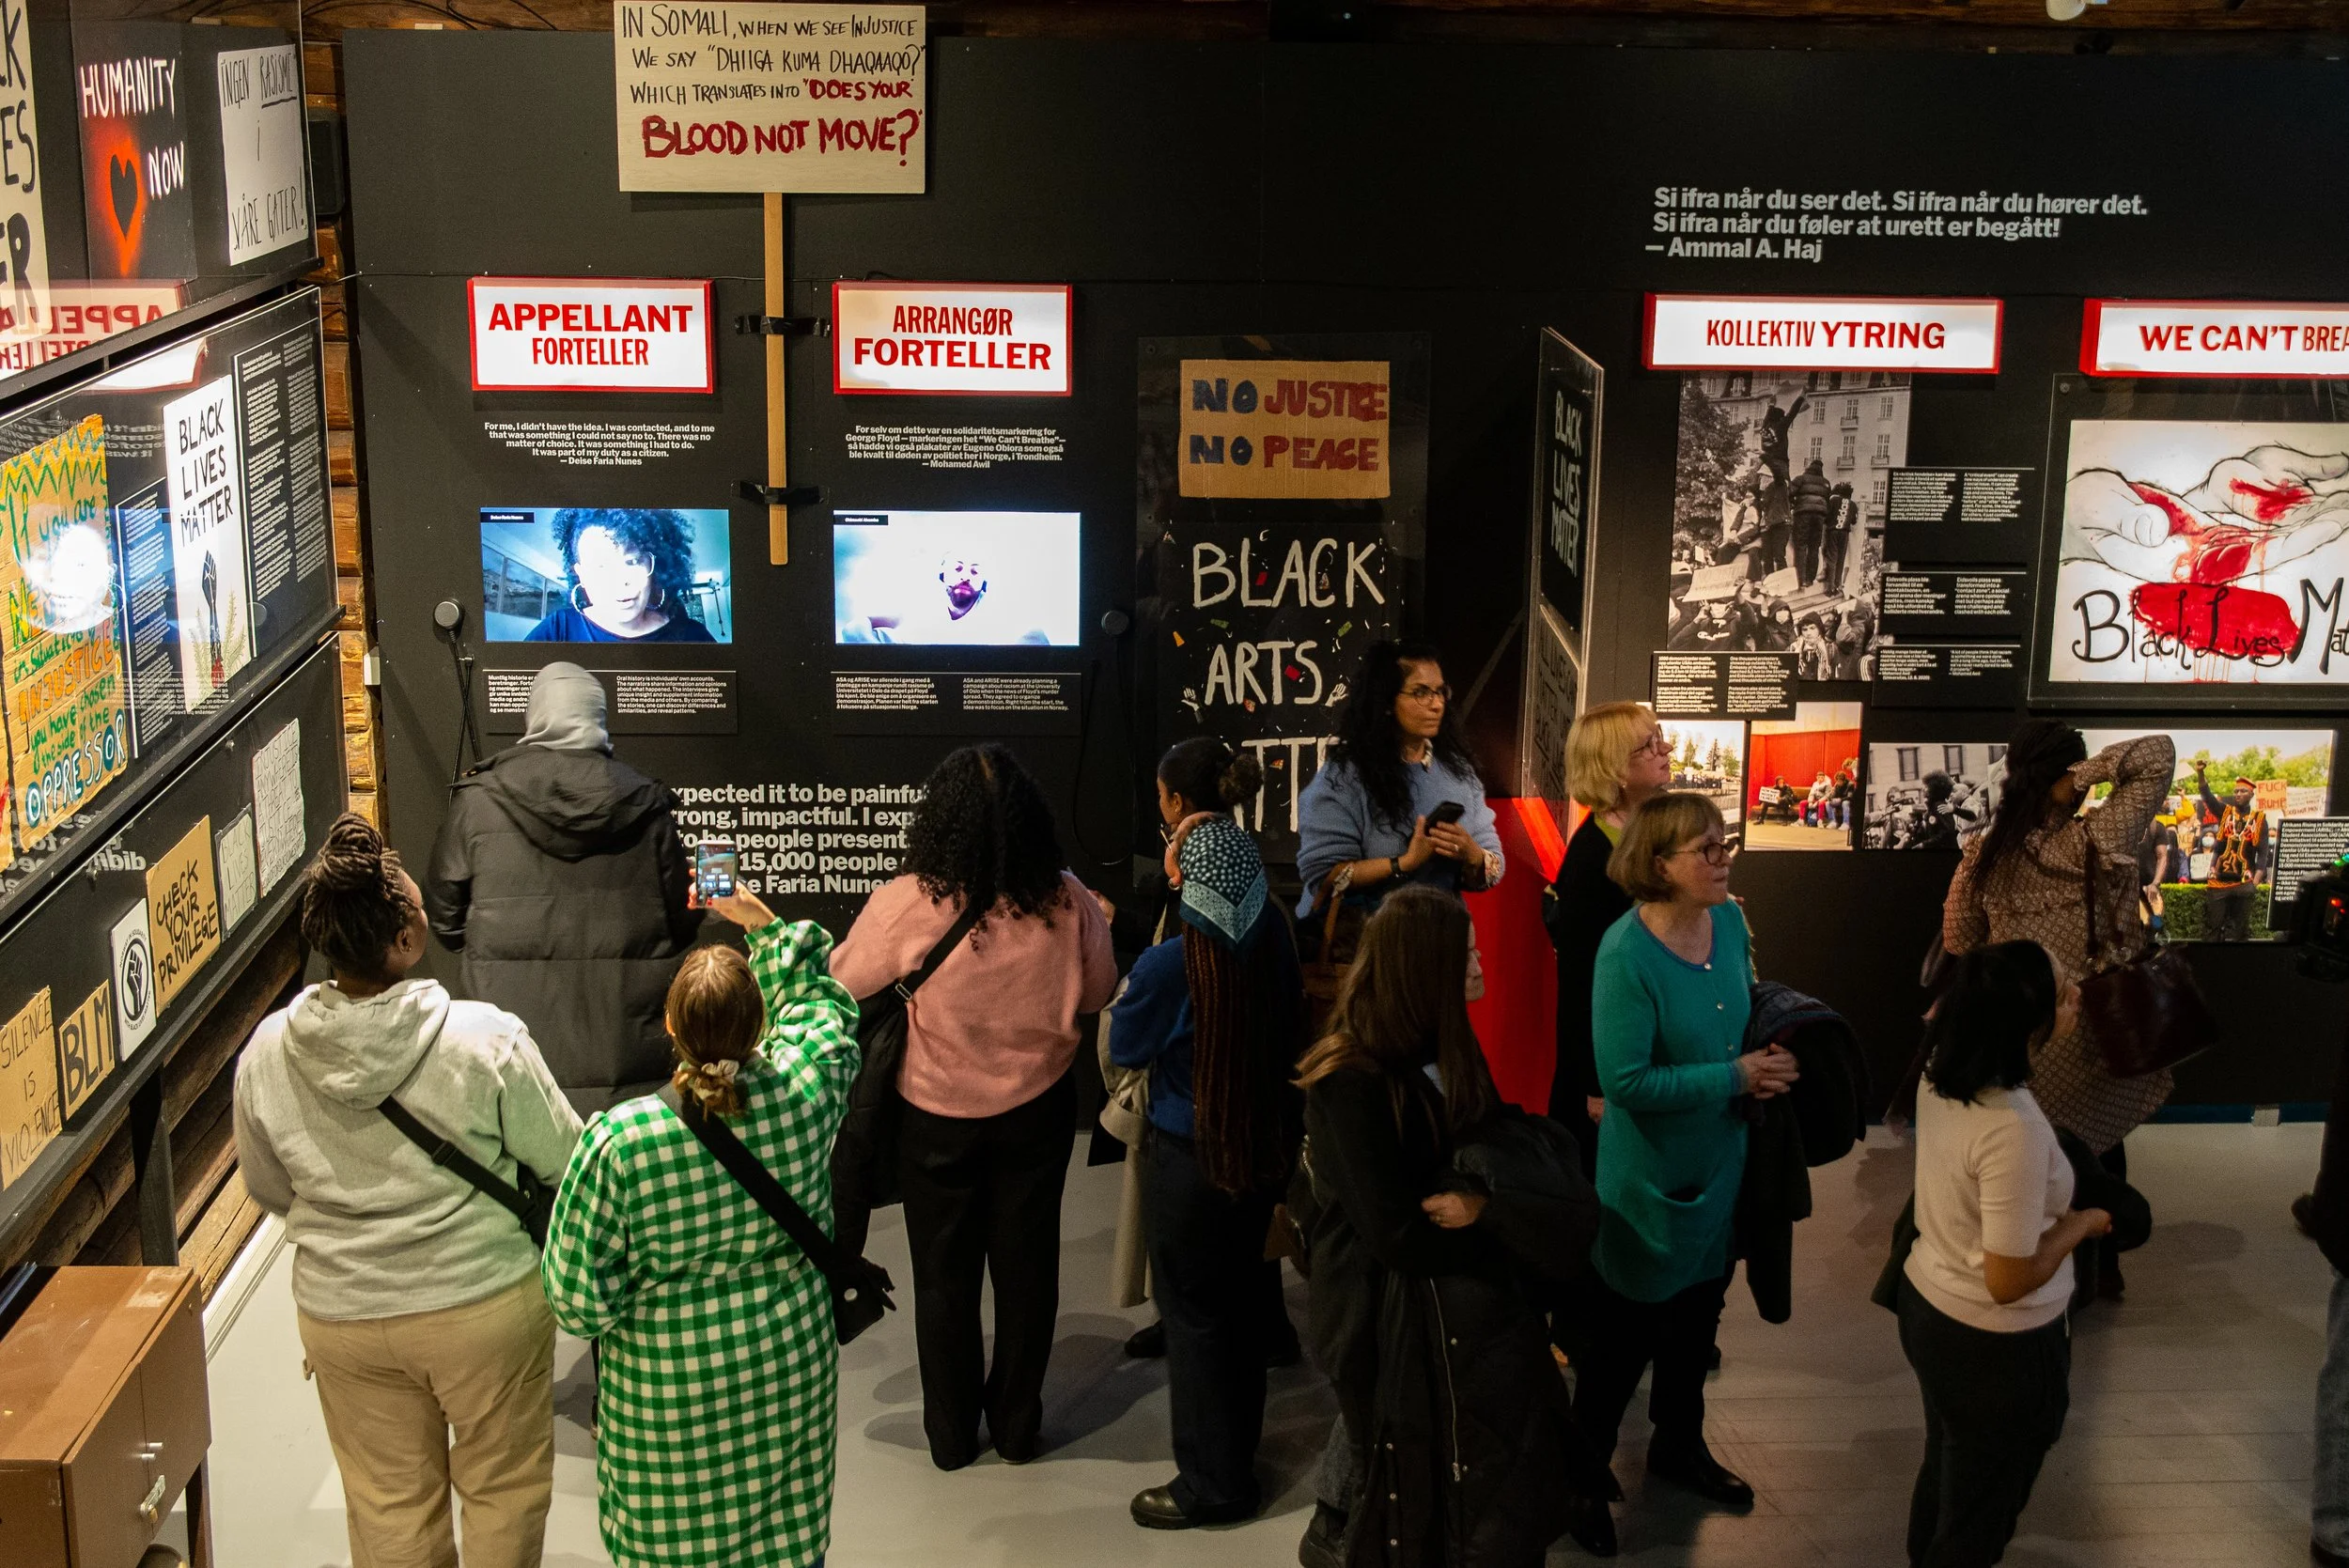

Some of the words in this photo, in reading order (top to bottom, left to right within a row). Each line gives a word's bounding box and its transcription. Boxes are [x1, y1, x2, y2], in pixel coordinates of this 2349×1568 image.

[622, 6, 644, 38] IN
[651, 4, 737, 39] SOMALI,
[738, 20, 787, 38] WHEN
[793, 20, 819, 37] WE
[822, 21, 848, 36] SEE
[850, 14, 917, 38] INJUSTICE
[665, 51, 696, 68] SAY
[782, 50, 820, 72] KUMA
[80, 57, 177, 119] HUMANITY
[630, 84, 687, 104] WHICH
[692, 84, 766, 103] TRANSLATES
[770, 85, 799, 98] INTO
[867, 80, 912, 100] YOUR
[642, 114, 748, 158] BLOOD
[754, 119, 810, 154] NOT
[148, 142, 185, 200] NOW
[232, 193, 261, 251] VÅRE
[267, 166, 307, 243] GATER!
[1655, 188, 1676, 209] Si
[1682, 189, 1719, 210] ifra
[1724, 189, 1763, 210] når
[1766, 190, 1797, 210] du
[1800, 195, 1838, 210] ser
[1842, 191, 1887, 211] det.
[1892, 192, 1914, 212] Si
[1919, 192, 1956, 212] ifra
[1961, 193, 1999, 213] når
[2003, 193, 2032, 213] du
[2037, 194, 2099, 214] hører
[2103, 194, 2147, 215] det.
[1653, 212, 1675, 233] Si
[1680, 213, 1718, 234] ifra
[1722, 213, 1762, 234] når
[1766, 214, 1795, 235] du
[1798, 214, 1854, 235] føler
[1857, 215, 1881, 236] at
[1886, 216, 1944, 237] urett
[1948, 222, 1972, 237] er
[1976, 217, 2060, 242] begått!
[1668, 238, 1751, 258] Ammal
[1755, 238, 1779, 258] A.
[1784, 239, 1822, 264] Haj
[489, 303, 693, 333] APPELLANT
[893, 305, 1013, 336] ARRANGØR
[1706, 319, 1816, 348] KOLLEKTIV
[1820, 320, 1946, 349] YTRING
[533, 337, 649, 365] FORTELLER
[854, 337, 1051, 370] FORTELLER
[2139, 325, 2193, 351] WE
[2200, 325, 2298, 351] CAN'T
[1191, 378, 1258, 414] NO
[179, 398, 225, 455] BLACK
[485, 423, 498, 431] For
[500, 424, 516, 432] me,
[517, 423, 520, 431] I
[521, 423, 545, 431] didn't
[547, 423, 567, 431] have
[568, 423, 583, 431] the
[583, 424, 604, 432] idea.
[627, 424, 673, 433] contacted,
[674, 424, 690, 432] and
[691, 424, 700, 432] to
[870, 426, 887, 434] selv
[903, 426, 926, 434] dette
[953, 427, 1043, 437] solidaritetsmarkering
[1555, 390, 1582, 458] BLACK
[972, 460, 990, 469] Awil
[1190, 435, 1253, 466] NO
[1263, 435, 1379, 471] PEACE
[181, 444, 226, 501] LIVES
[1553, 449, 1580, 519] LIVES
[180, 486, 234, 548] MATTER
[1835, 498, 1850, 529] adidas
[1551, 501, 1579, 578] MATTER
[1192, 537, 1385, 608] BLACK
[2072, 589, 2191, 670] Black
[2195, 587, 2285, 667] Lives
[19, 617, 114, 724] INJUSTICE
[1205, 642, 1322, 705] ARTS
[31, 727, 46, 774] you
[49, 704, 77, 737] have
[80, 673, 116, 710] chosen
[40, 750, 56, 768] the
[57, 729, 75, 755] side
[89, 706, 109, 730] the
[25, 708, 126, 829] OPPRESSOR
[770, 784, 786, 803] it
[788, 784, 813, 803] to
[818, 784, 847, 803] be
[851, 784, 926, 807] painfu
[2257, 798, 2286, 809] TRUMP
[2258, 782, 2287, 793] FUCK
[742, 807, 858, 830] impactful.
[863, 807, 869, 826] I
[221, 817, 251, 864] BLACK
[735, 831, 813, 853] people
[739, 853, 815, 876] 15,000
[819, 853, 897, 876] people
[156, 859, 198, 925] CHECK
[766, 875, 819, 893] Faria
[165, 891, 200, 945] YOUR
[159, 900, 218, 992] PRIVILEGE
[1, 995, 54, 1069] SILENCE
[62, 995, 114, 1105] BLM
[23, 1070, 36, 1102] IS
[6, 1089, 60, 1173] VIOLENCE
